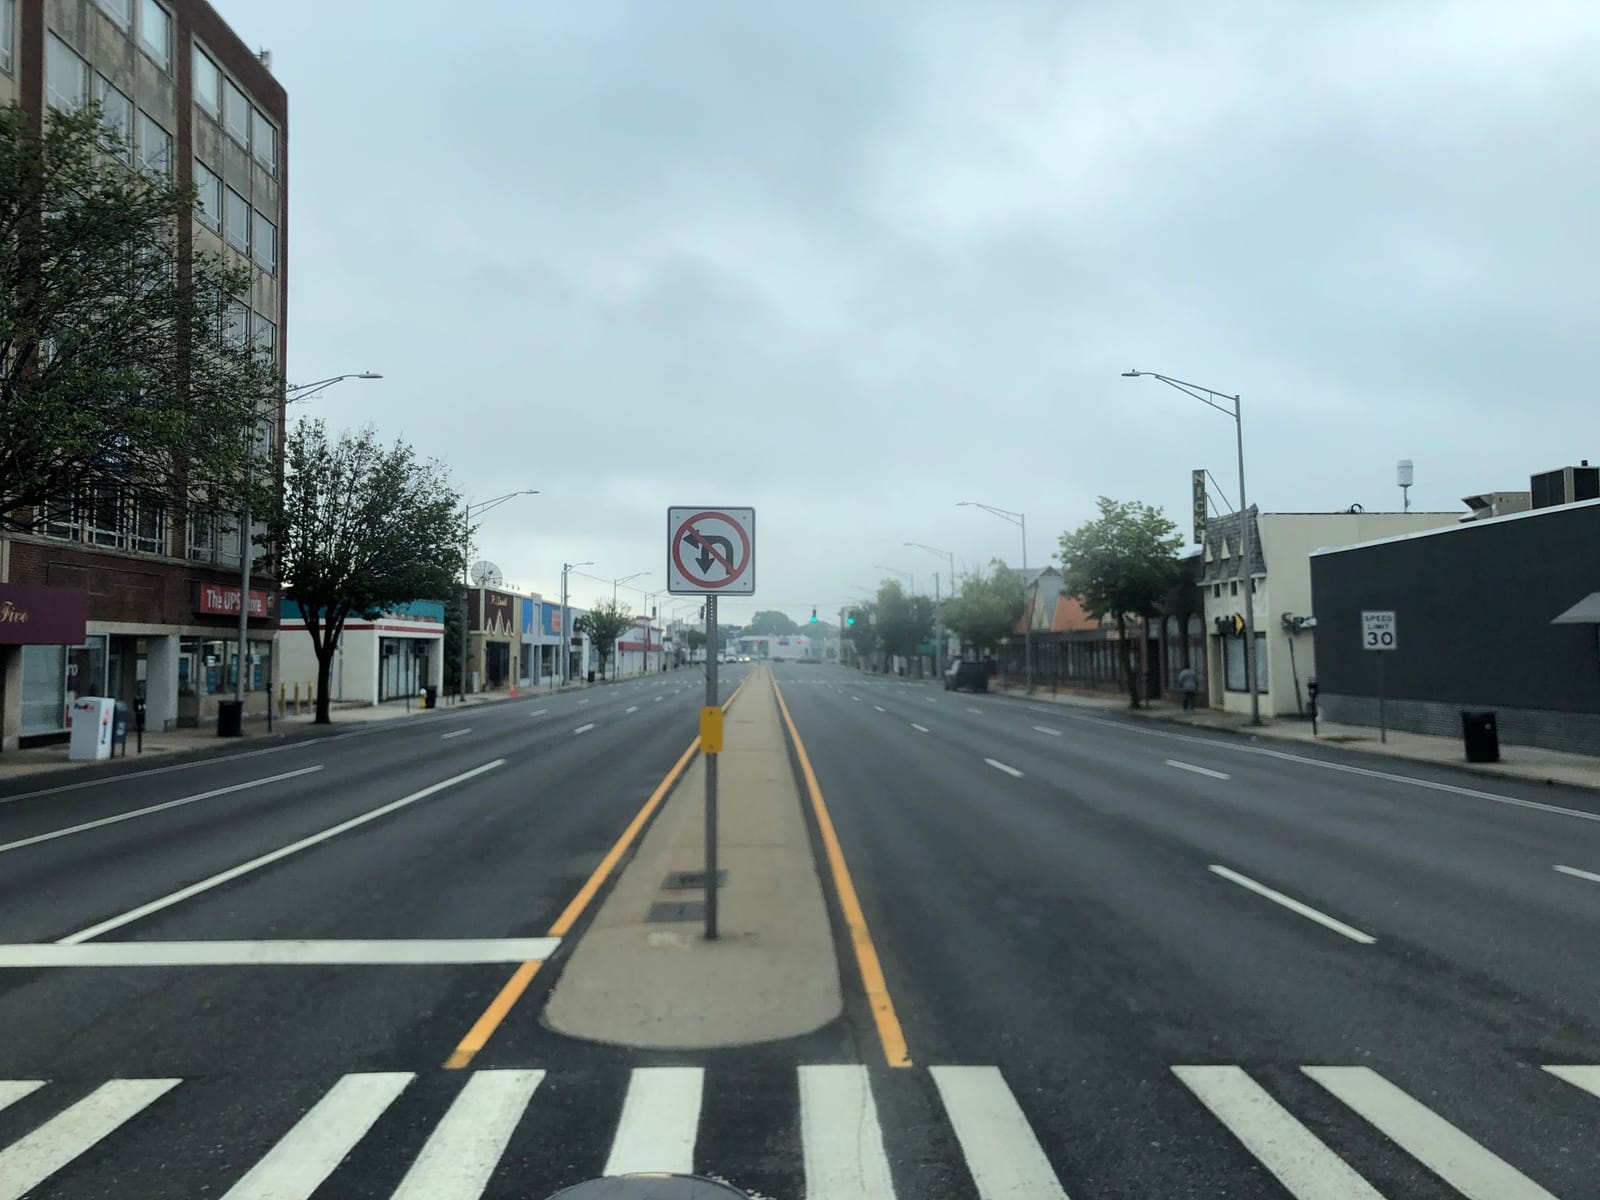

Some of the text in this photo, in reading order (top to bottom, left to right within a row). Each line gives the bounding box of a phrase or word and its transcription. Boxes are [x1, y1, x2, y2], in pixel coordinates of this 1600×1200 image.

[207, 589, 223, 608] The
[224, 592, 241, 610] UPS
[1364, 614, 1393, 622] SPEED
[1367, 631, 1393, 646] 30
